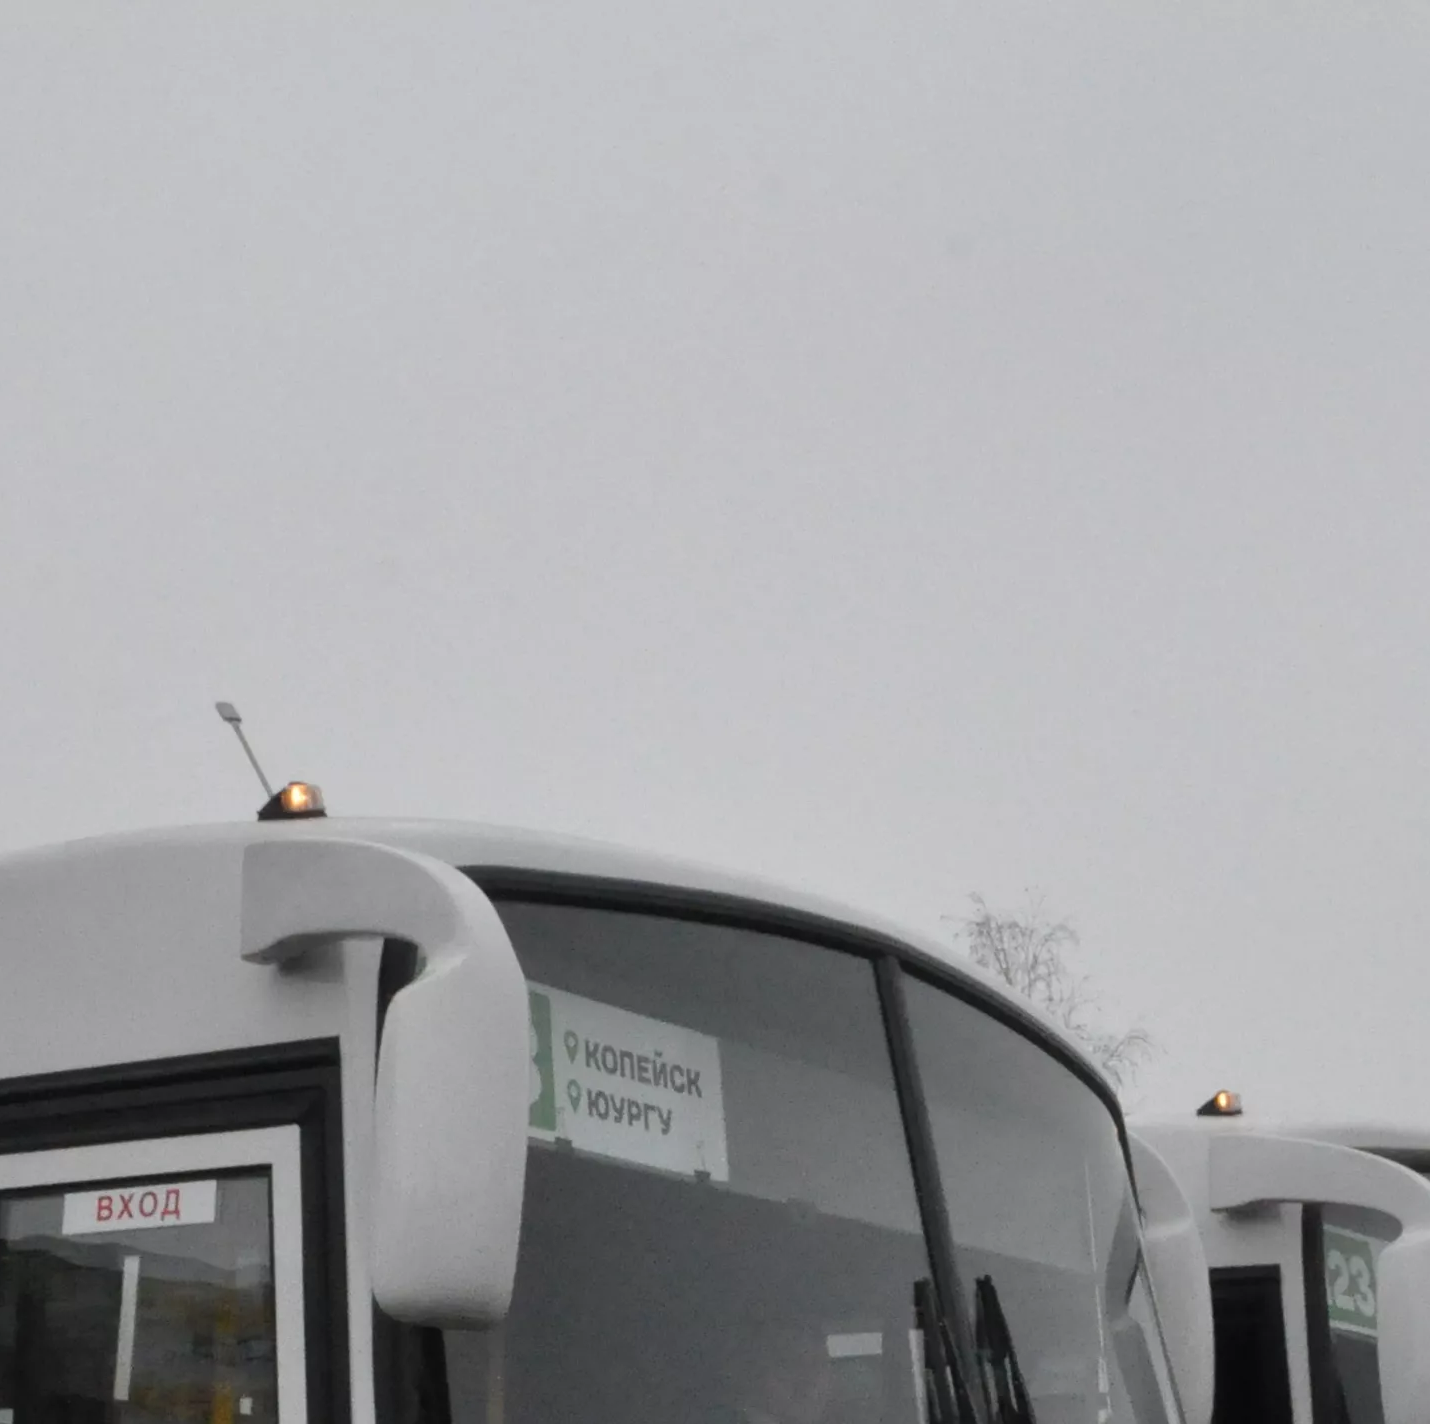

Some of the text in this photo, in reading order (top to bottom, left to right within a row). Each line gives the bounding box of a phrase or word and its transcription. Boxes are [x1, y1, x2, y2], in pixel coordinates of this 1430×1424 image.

[584, 1039, 703, 1098] КОПЕЙСК
[587, 1087, 673, 1135] ЮУРГУ
[97, 1188, 180, 1222] ВХОД
